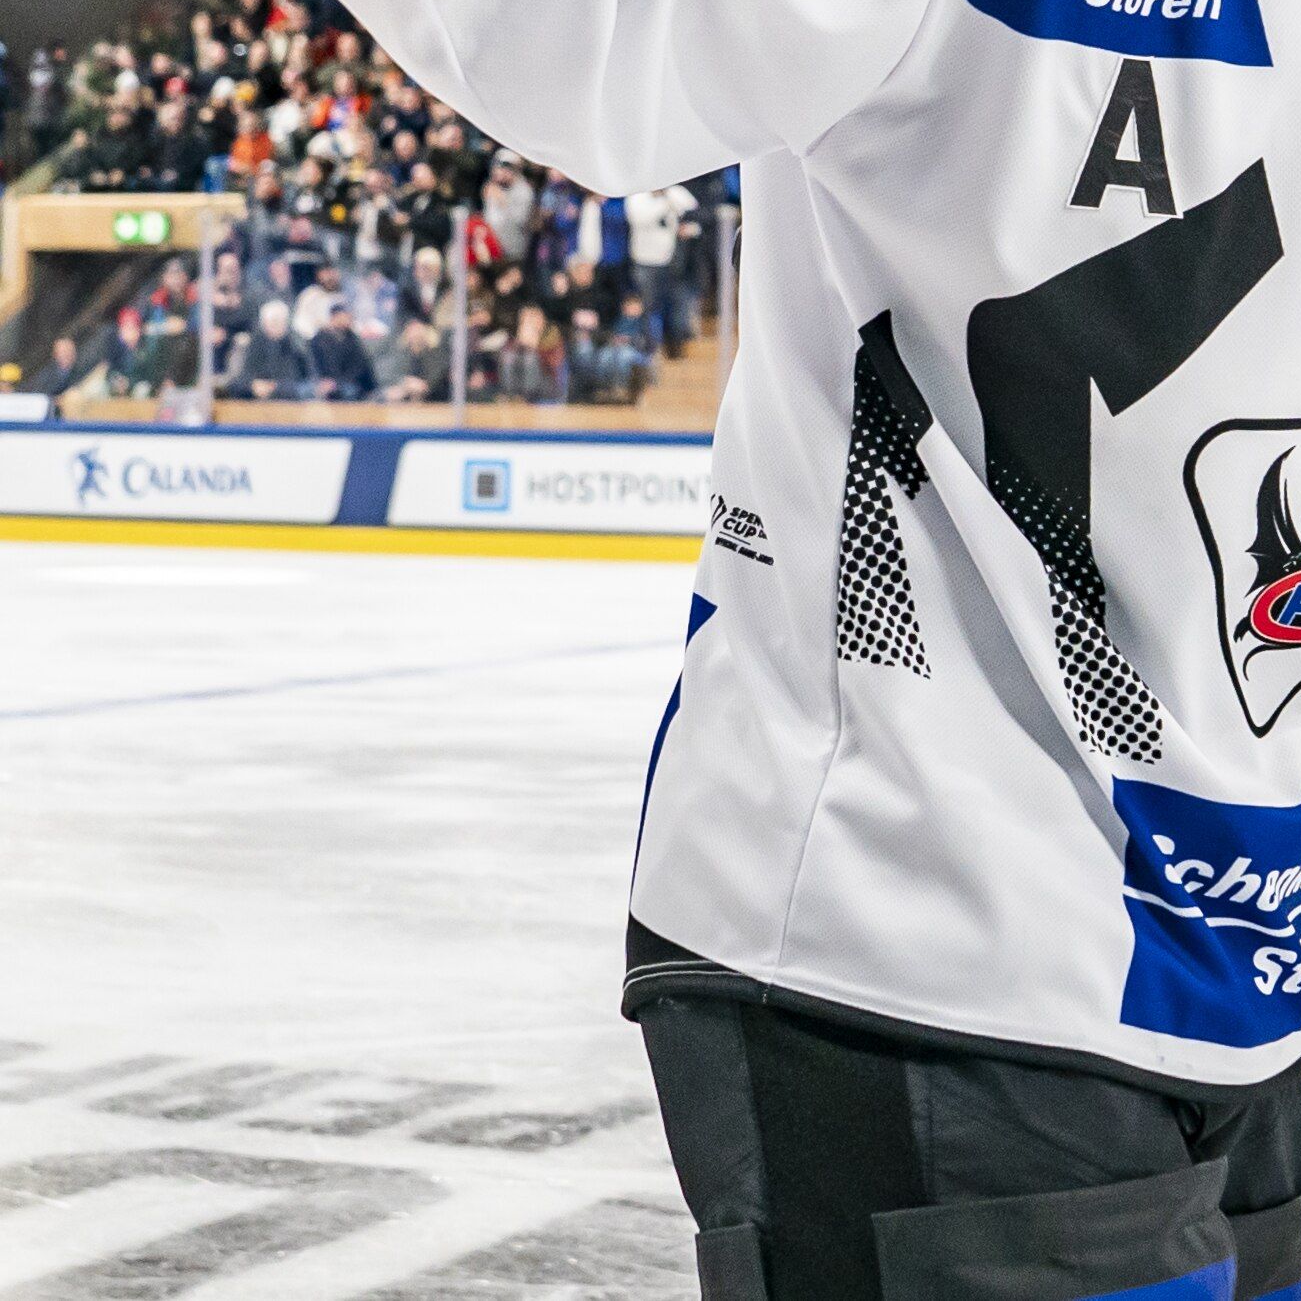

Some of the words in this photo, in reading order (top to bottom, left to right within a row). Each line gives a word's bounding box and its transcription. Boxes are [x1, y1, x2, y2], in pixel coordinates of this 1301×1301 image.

[1068, 59, 1181, 218] A
[527, 471, 711, 502] HOSTPOIN
[723, 518, 757, 538] CUP
